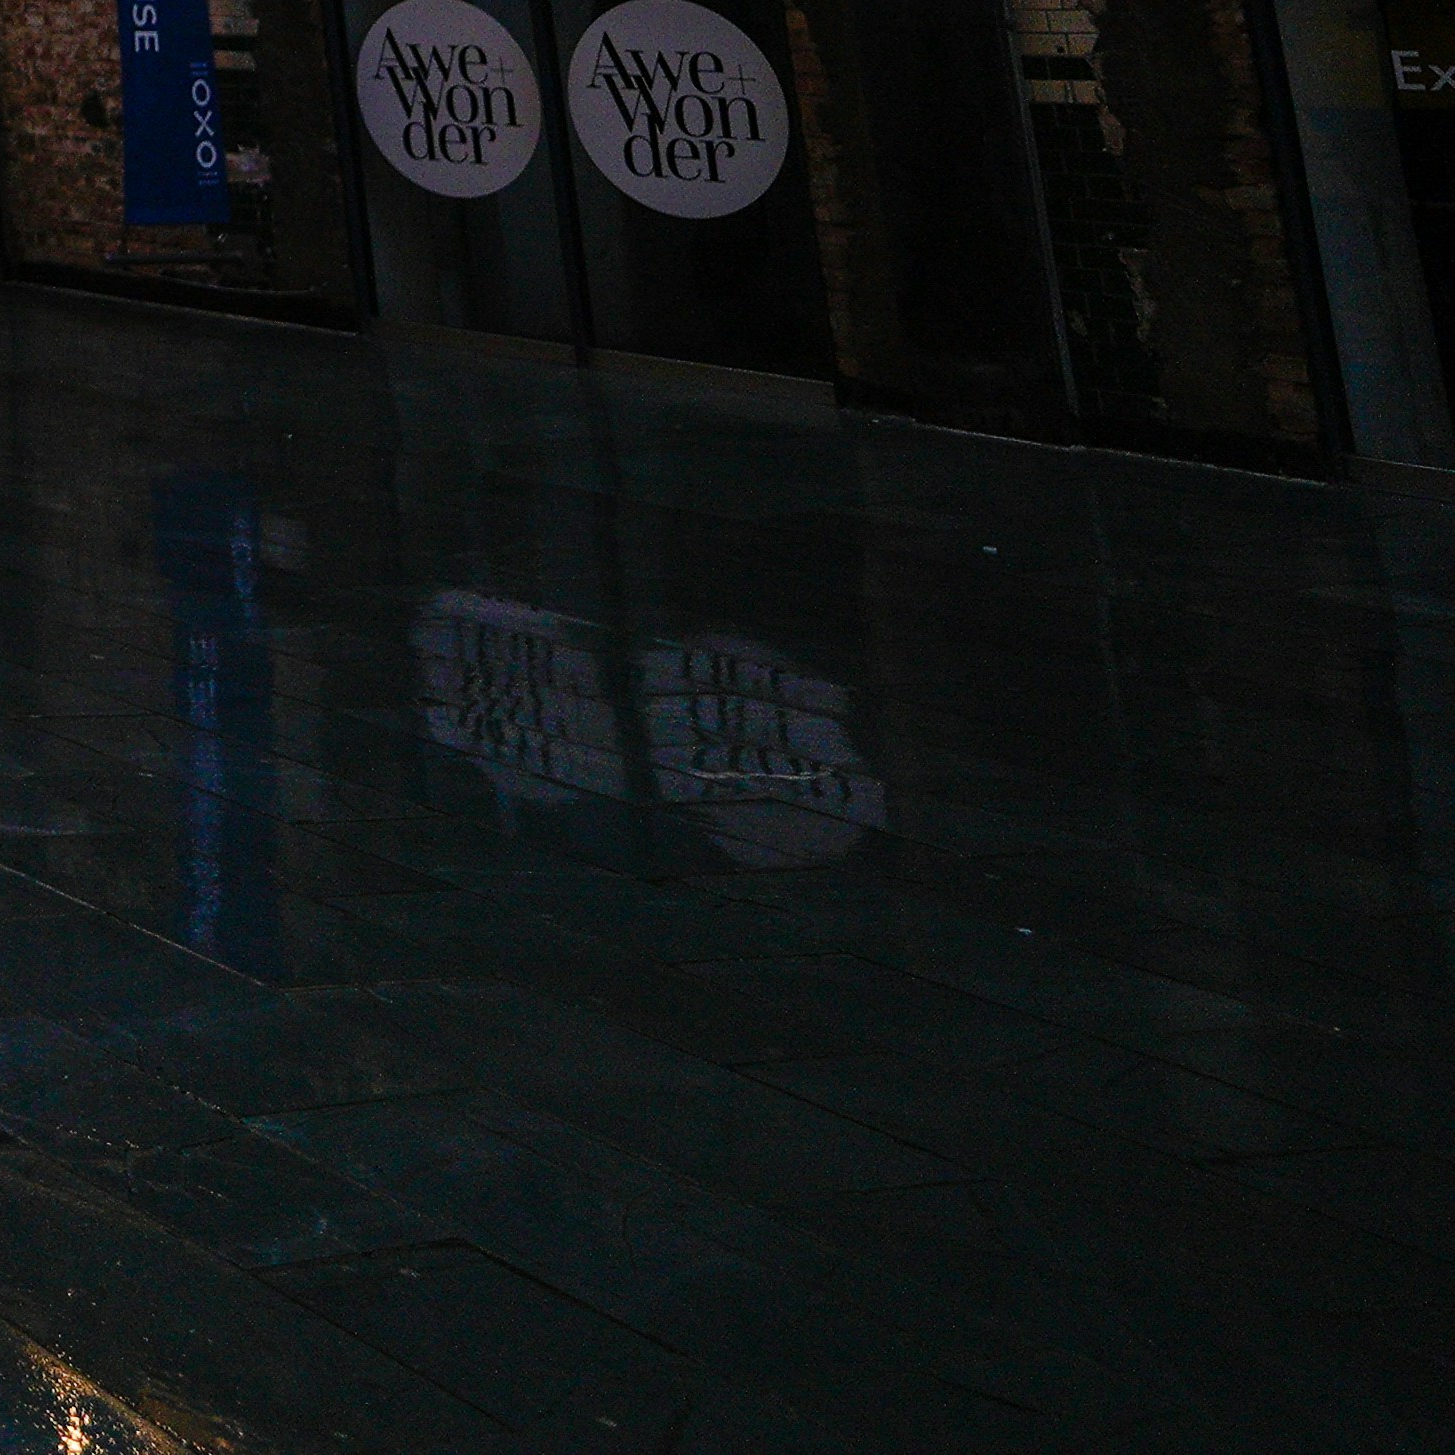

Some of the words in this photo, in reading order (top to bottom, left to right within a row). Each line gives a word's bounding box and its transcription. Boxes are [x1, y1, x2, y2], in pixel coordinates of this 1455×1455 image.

[191, 78, 218, 170] OXO
[388, 65, 524, 128] Won
[602, 73, 767, 142] Won
[402, 100, 497, 166] der
[623, 111, 736, 184] der
